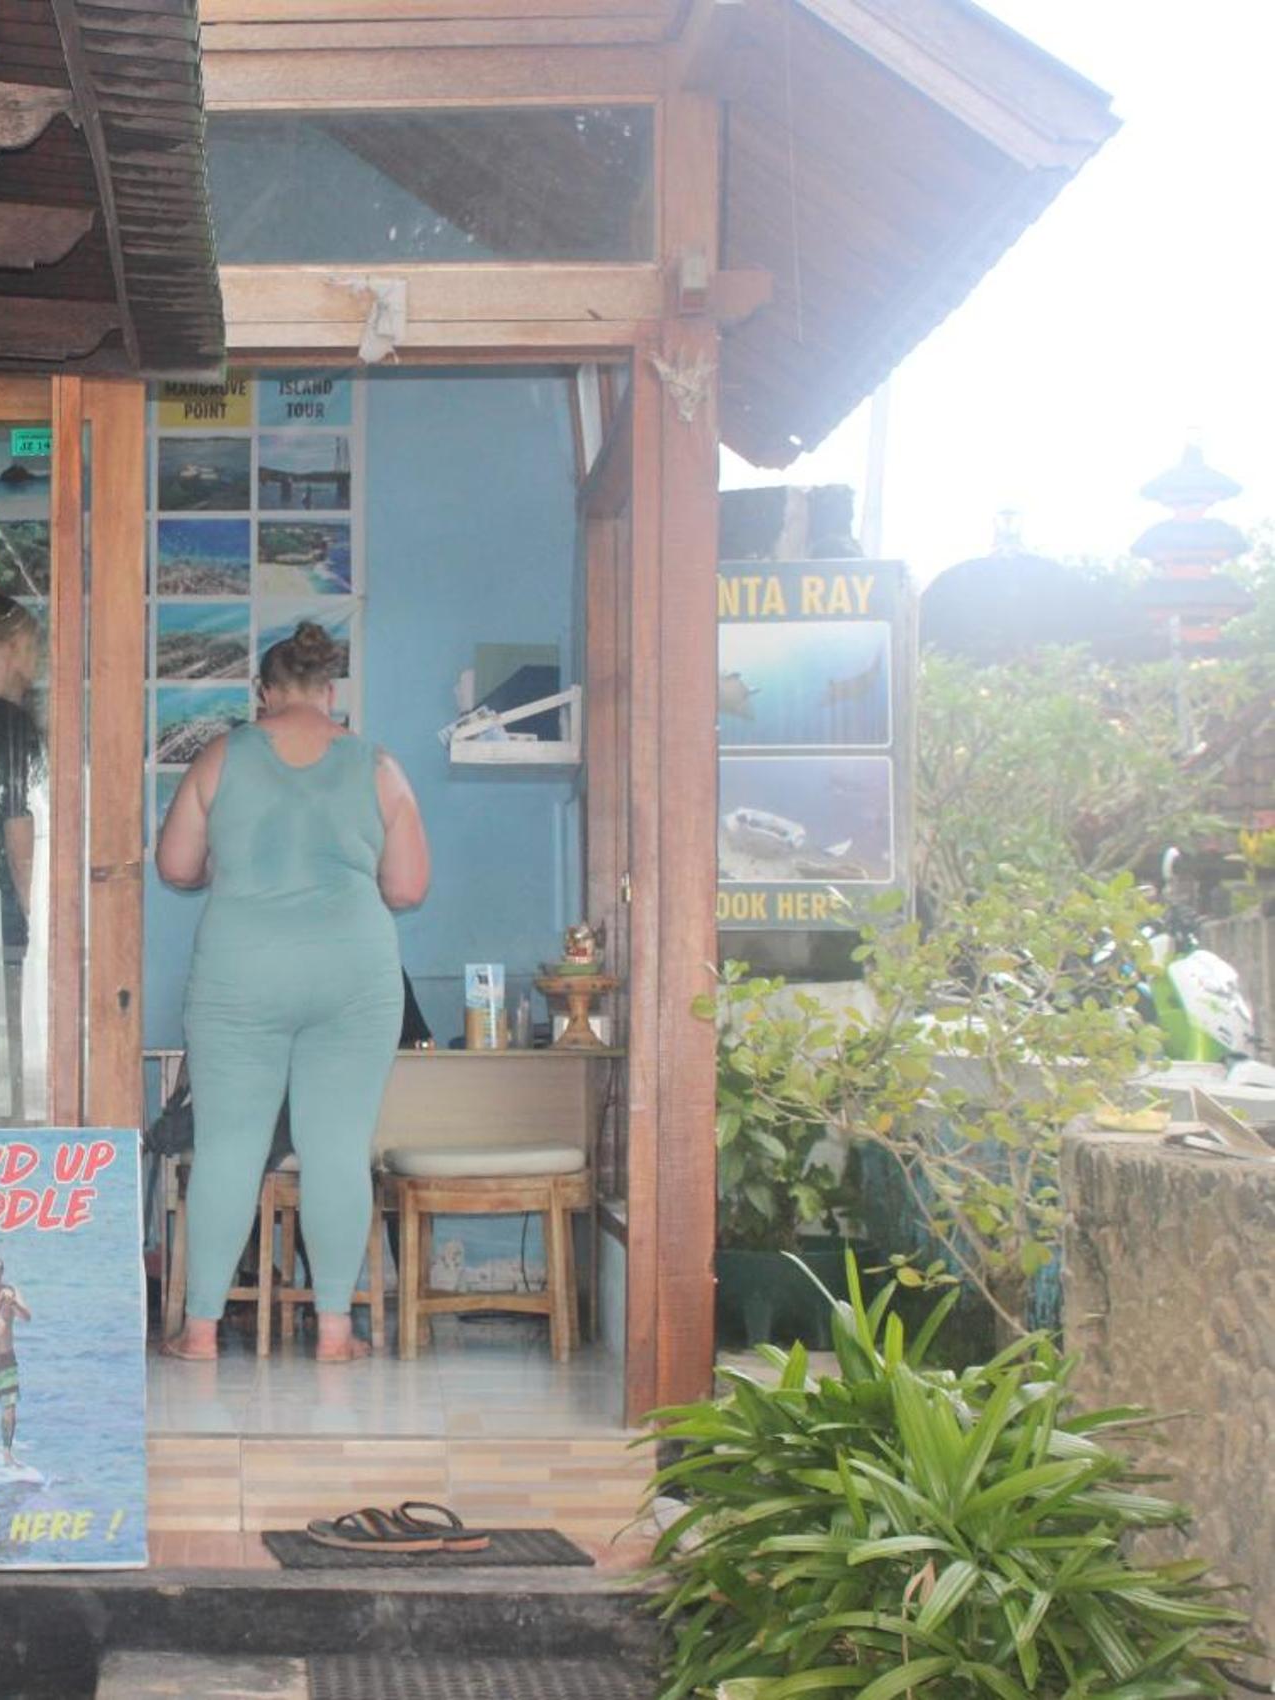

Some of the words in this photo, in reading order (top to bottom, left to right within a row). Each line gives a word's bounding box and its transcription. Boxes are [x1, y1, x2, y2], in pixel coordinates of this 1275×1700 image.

[279, 380, 333, 396] ISLAND
[184, 402, 228, 420] POINT
[287, 402, 326, 419] TOUR
[716, 574, 787, 617] NTA
[801, 573, 875, 615] RAY
[716, 892, 768, 921] OOK
[53, 1140, 116, 1184] UP
[10, 1510, 94, 1543] HERE
